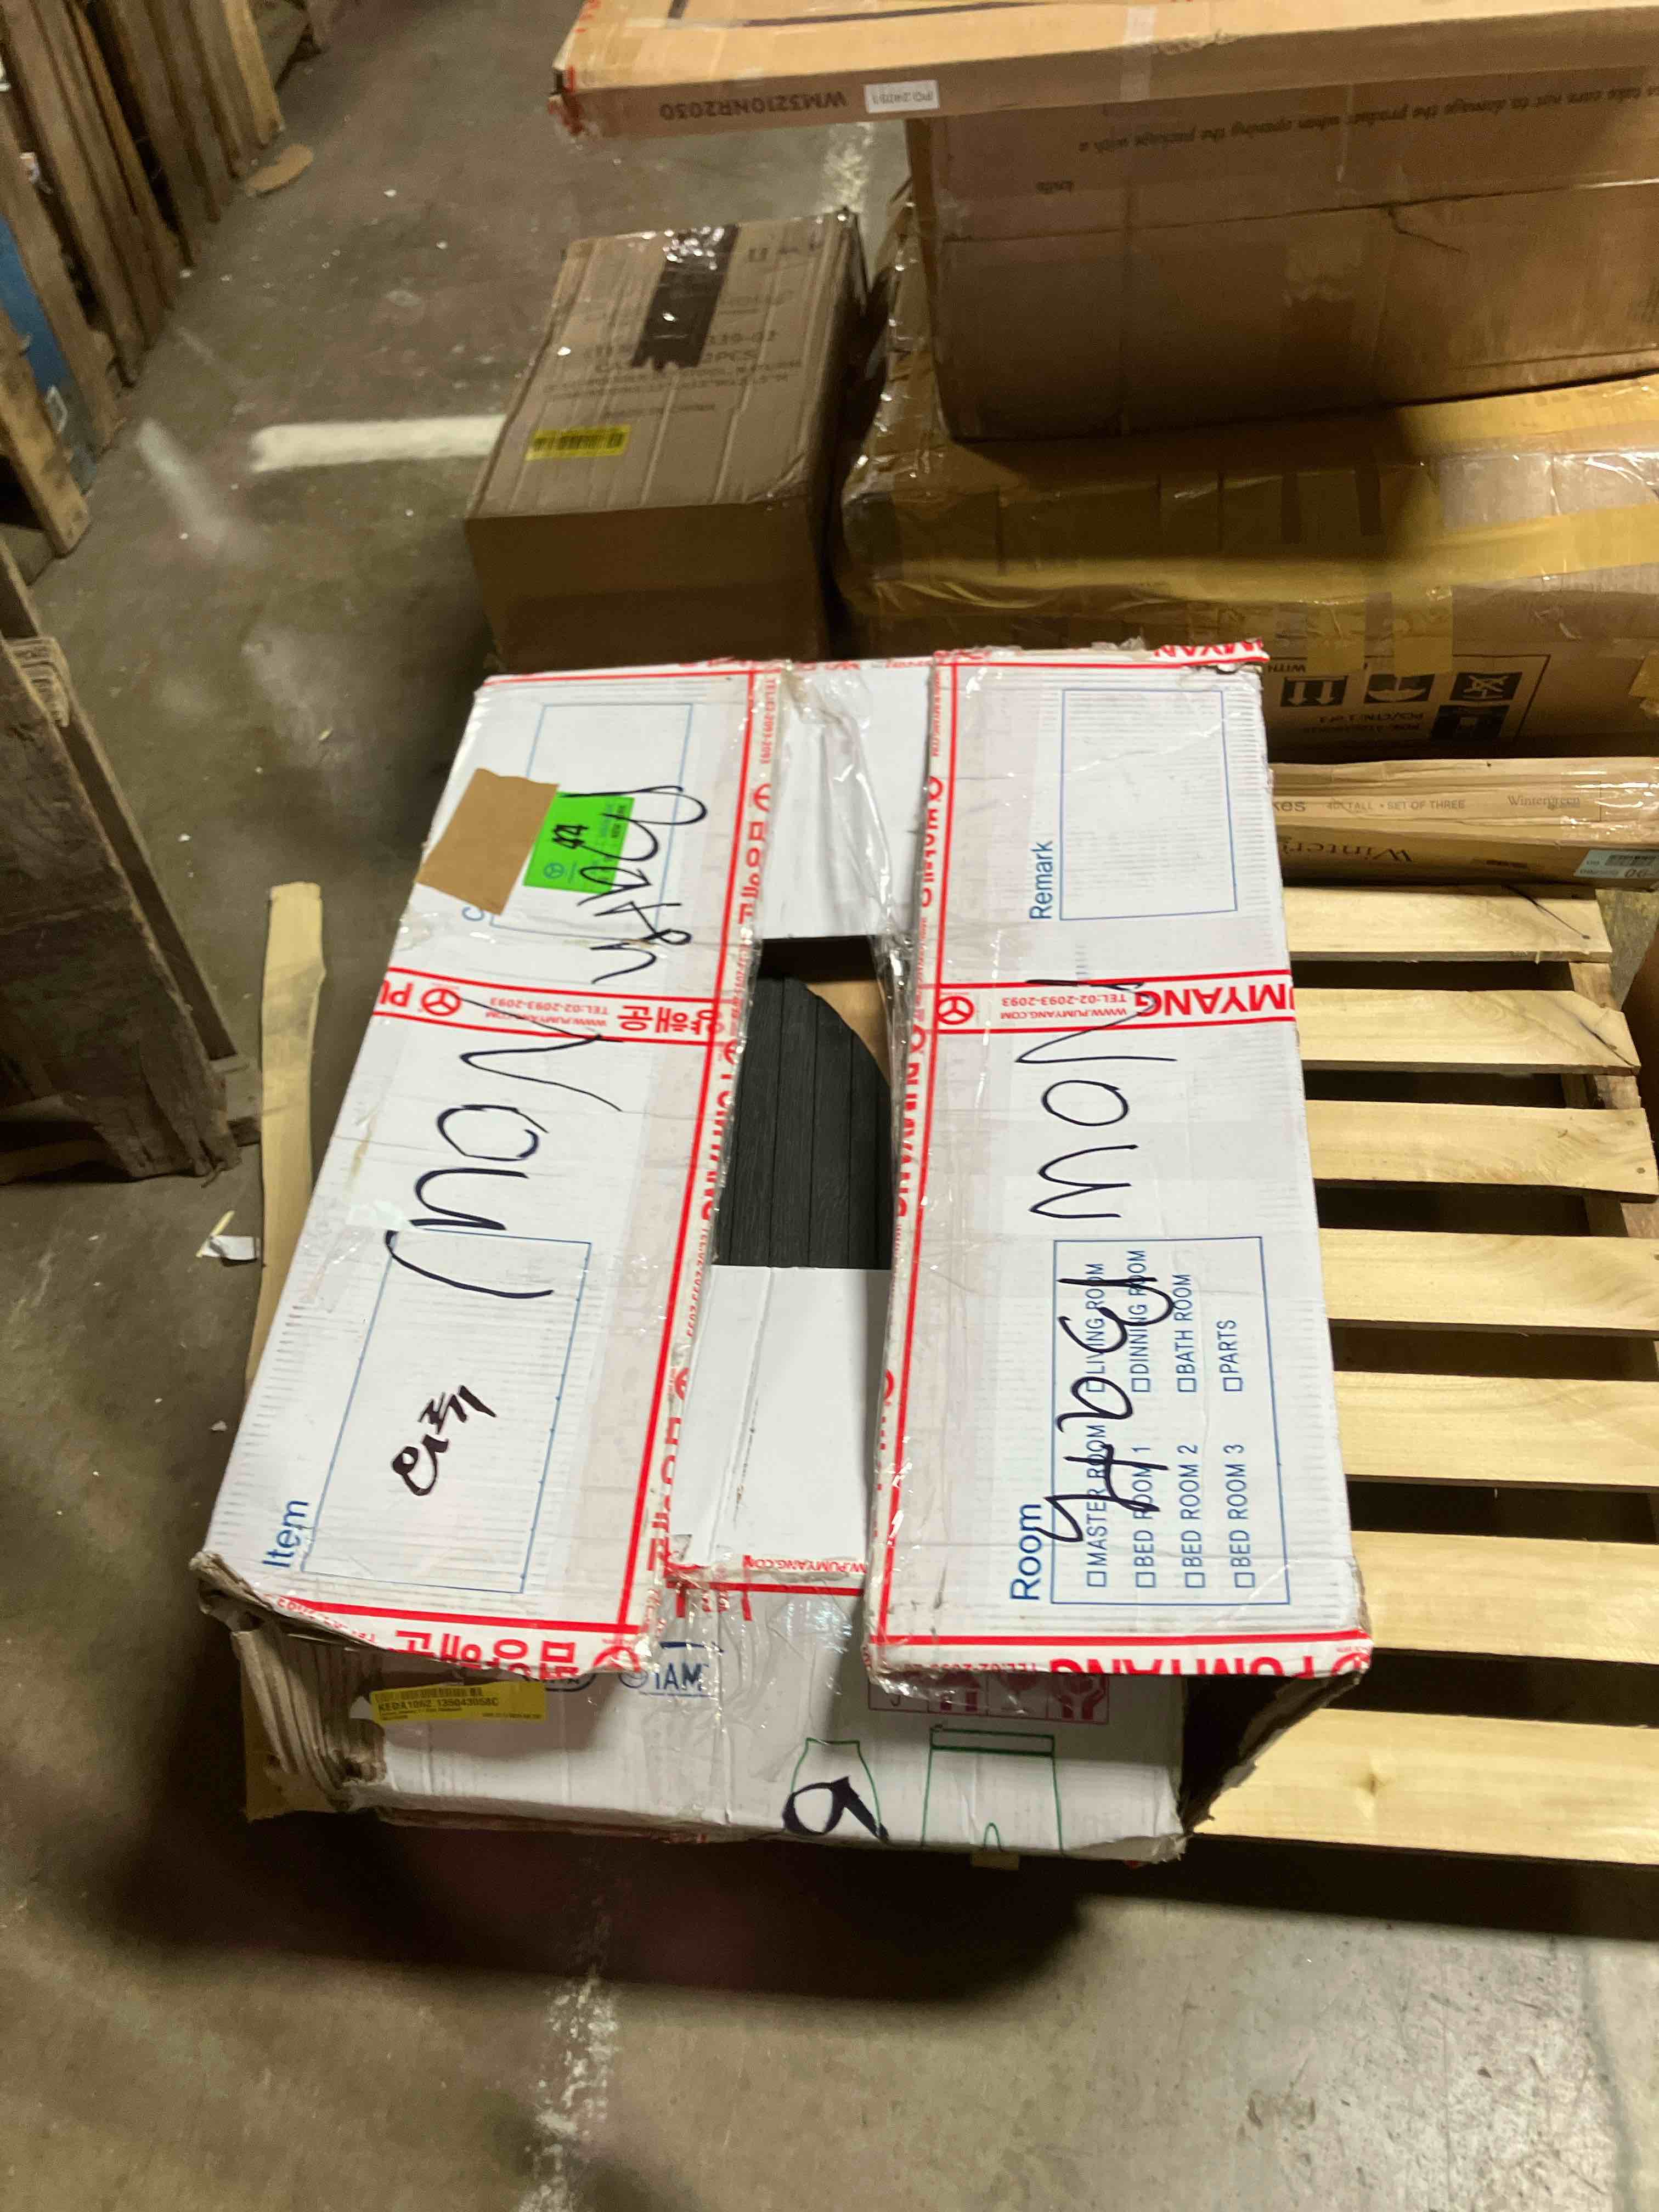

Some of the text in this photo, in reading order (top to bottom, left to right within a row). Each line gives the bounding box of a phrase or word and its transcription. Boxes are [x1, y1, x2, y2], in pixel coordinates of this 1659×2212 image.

[1029, 841, 1054, 920] Remark
[490, 998, 610, 1015] TEL:02-2093-2093
[1000, 1009, 1126, 1019] WWW.PUMYANG.COM
[1002, 994, 1126, 1006] TEL:02-2093-2093
[1129, 1303, 1150, 1374] DINNING
[1173, 1274, 1195, 1375] BATH ROOM
[1217, 1319, 1239, 1374] PARTS
[263, 1500, 308, 1567] Item
[1086, 1483, 1107, 1566] MASTER
[1177, 1444, 1203, 1567] BED ROOM 2
[1224, 1444, 1252, 1567] BED ROOM 3
[1009, 1503, 1042, 1601] Room
[1134, 1529, 1154, 1567] BED
